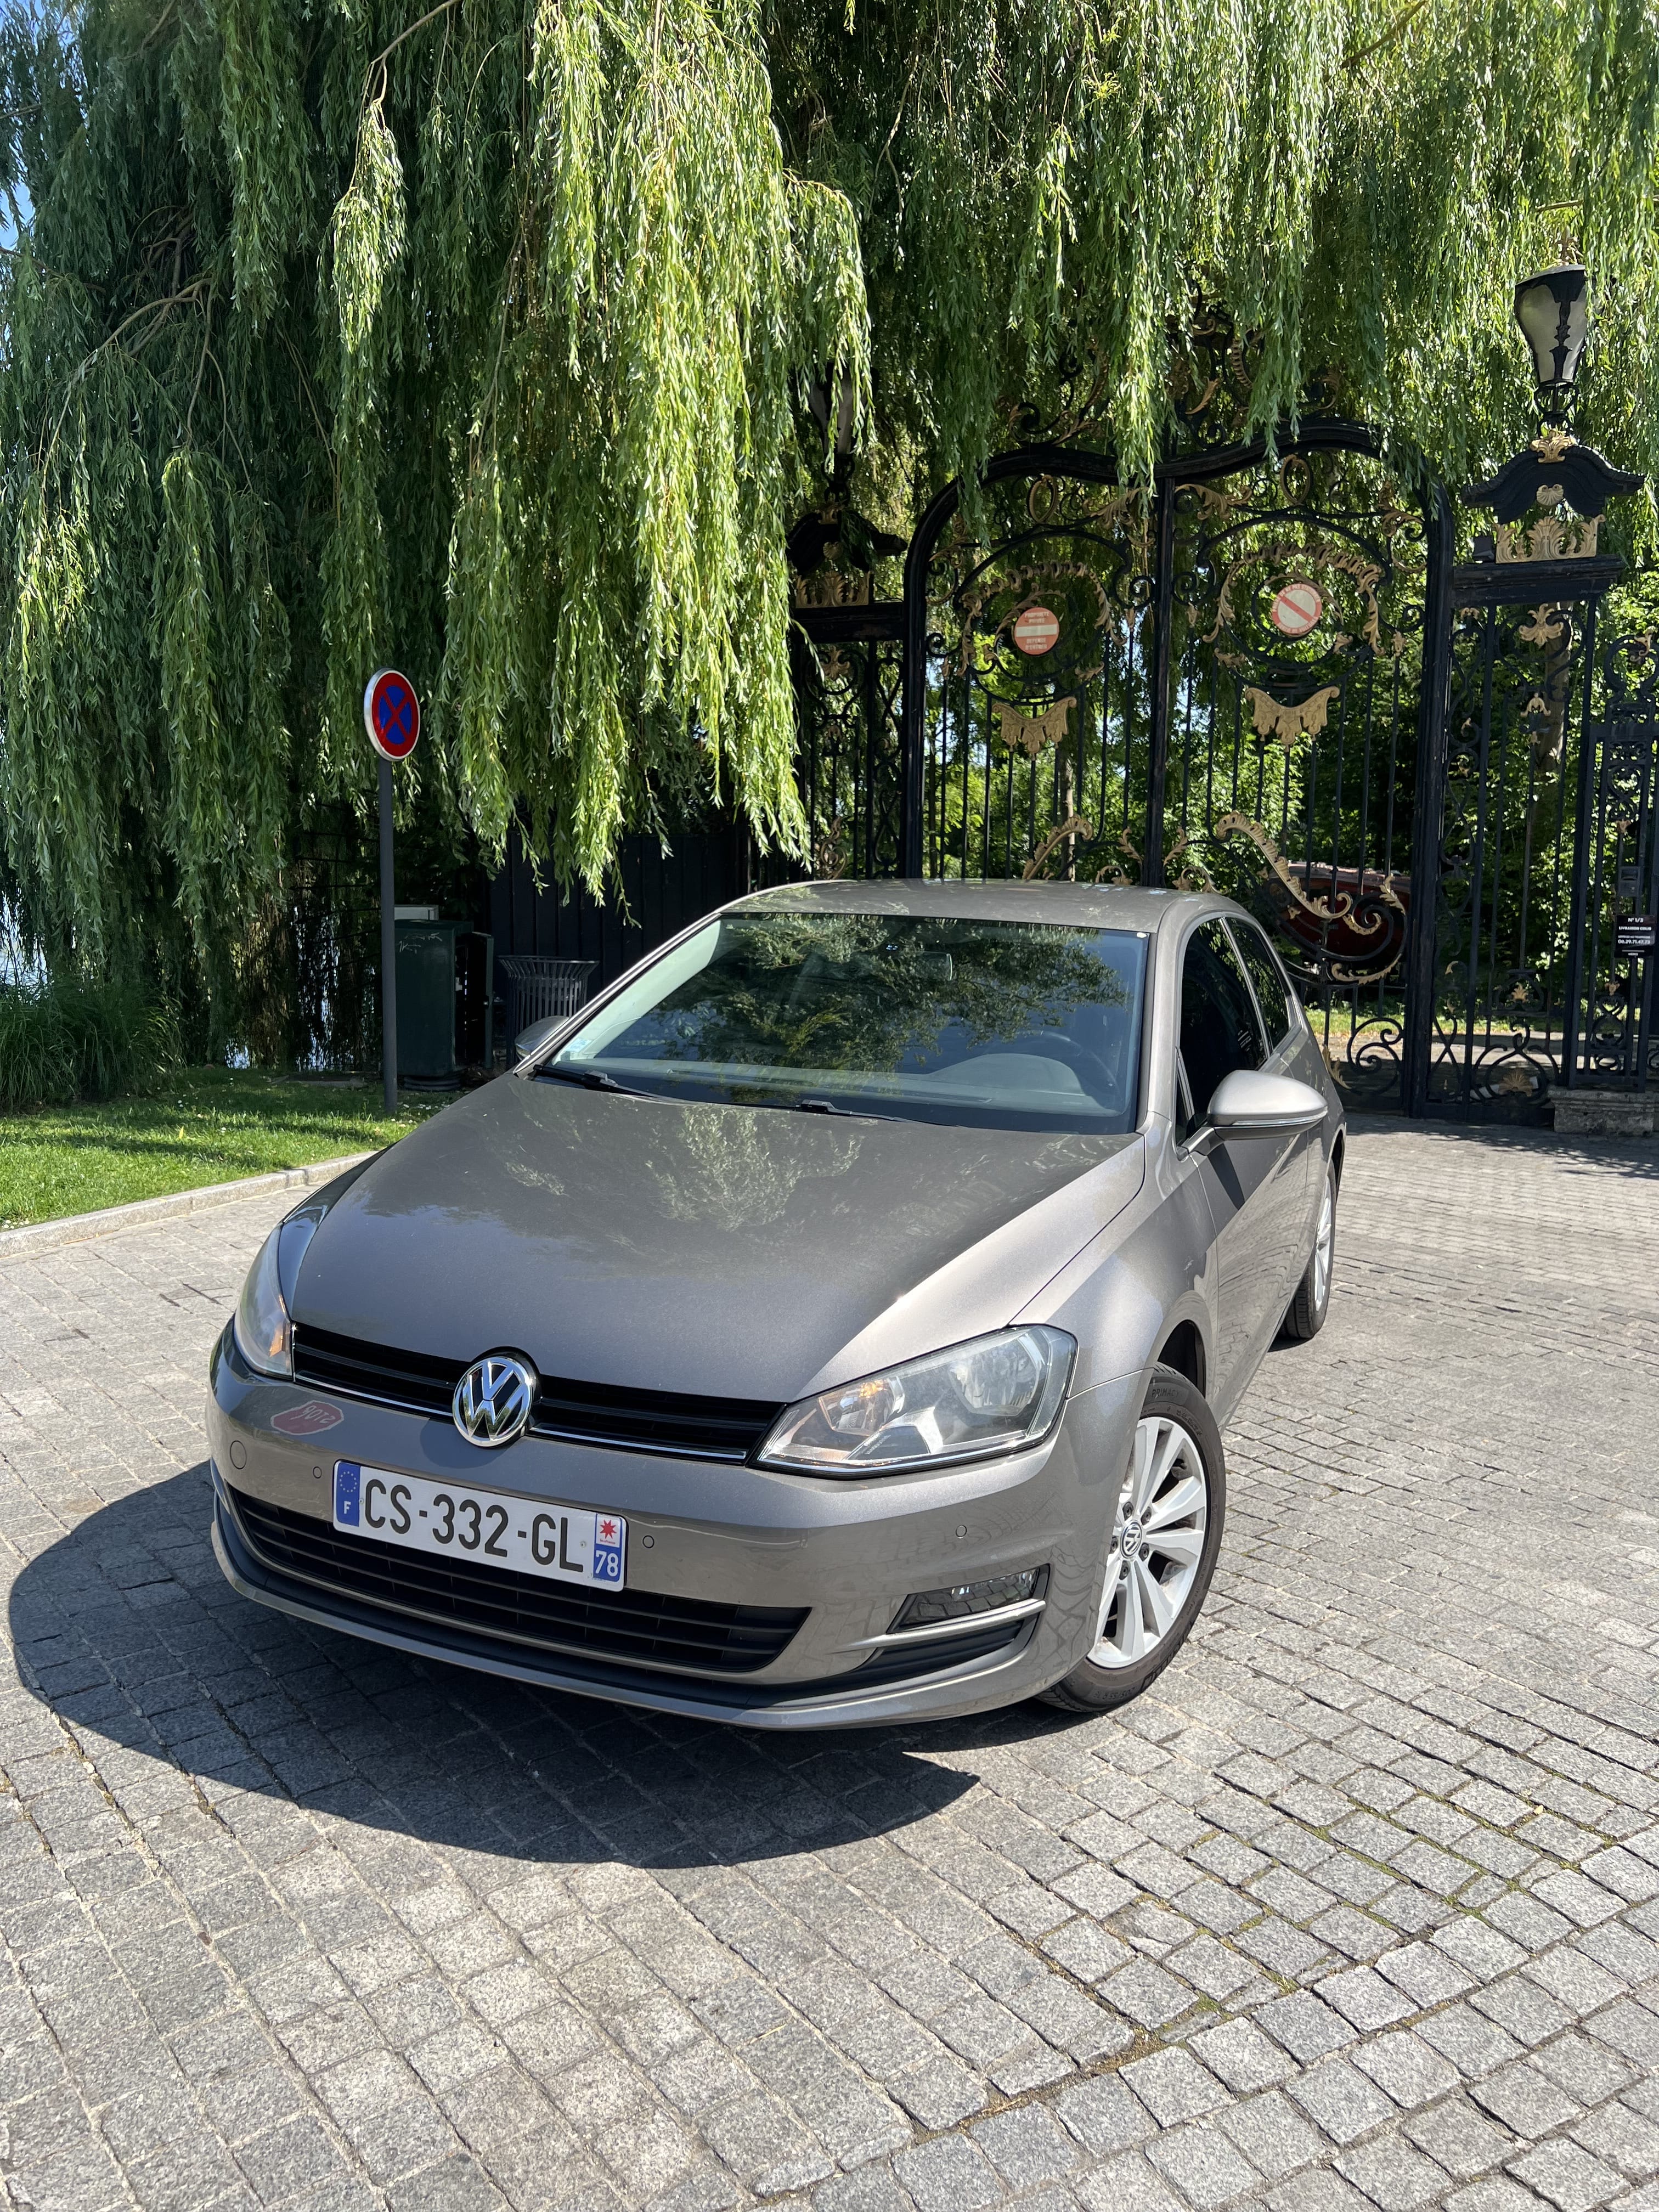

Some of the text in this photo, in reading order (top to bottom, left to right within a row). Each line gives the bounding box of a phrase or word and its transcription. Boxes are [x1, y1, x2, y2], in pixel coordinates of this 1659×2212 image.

[1152, 1387, 1179, 1397] PRIMACY
[343, 1500, 352, 1514] F
[365, 1479, 584, 1572] CS-332-GL
[595, 1550, 619, 1577] 78
